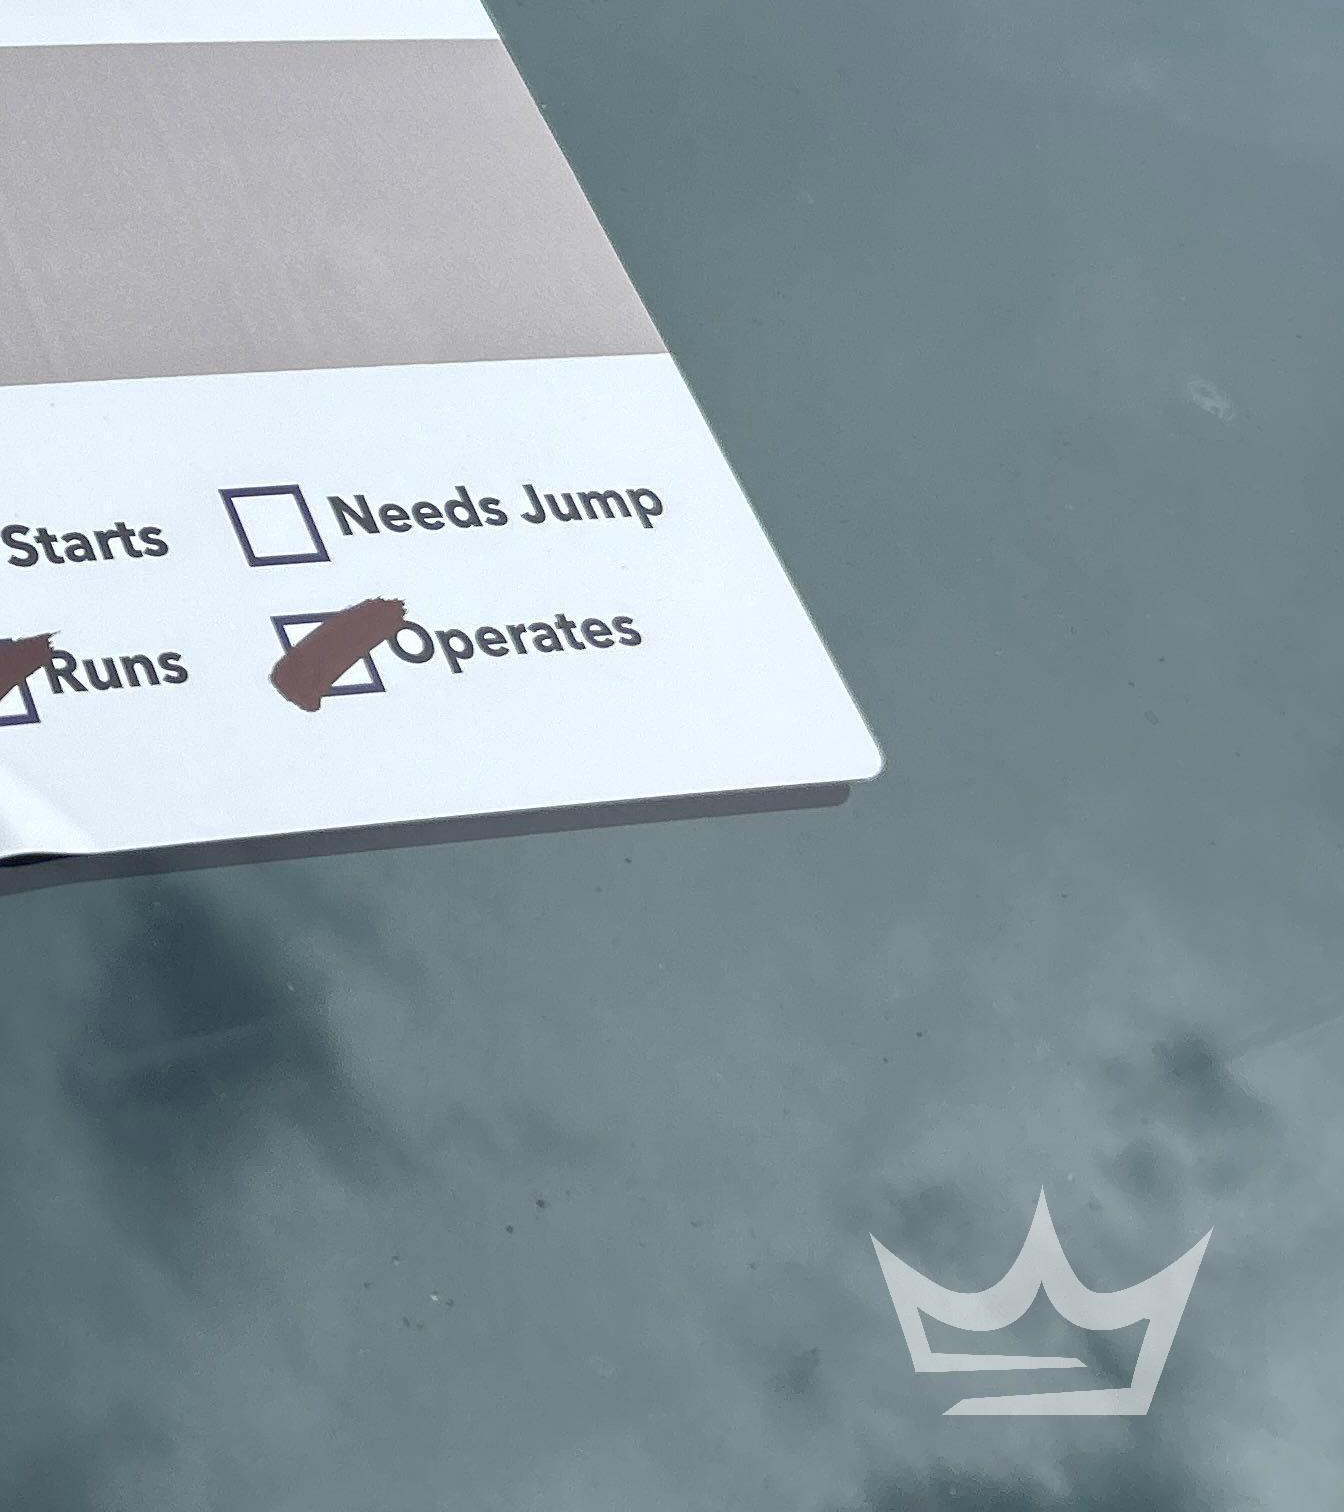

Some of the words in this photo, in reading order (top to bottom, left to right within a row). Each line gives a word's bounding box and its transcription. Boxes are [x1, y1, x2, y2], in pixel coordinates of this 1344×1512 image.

[326, 486, 508, 538] Needs
[519, 483, 664, 529] Jump
[0, 520, 169, 568] Starts
[388, 611, 642, 674] Operates
[46, 649, 189, 694] Runs
